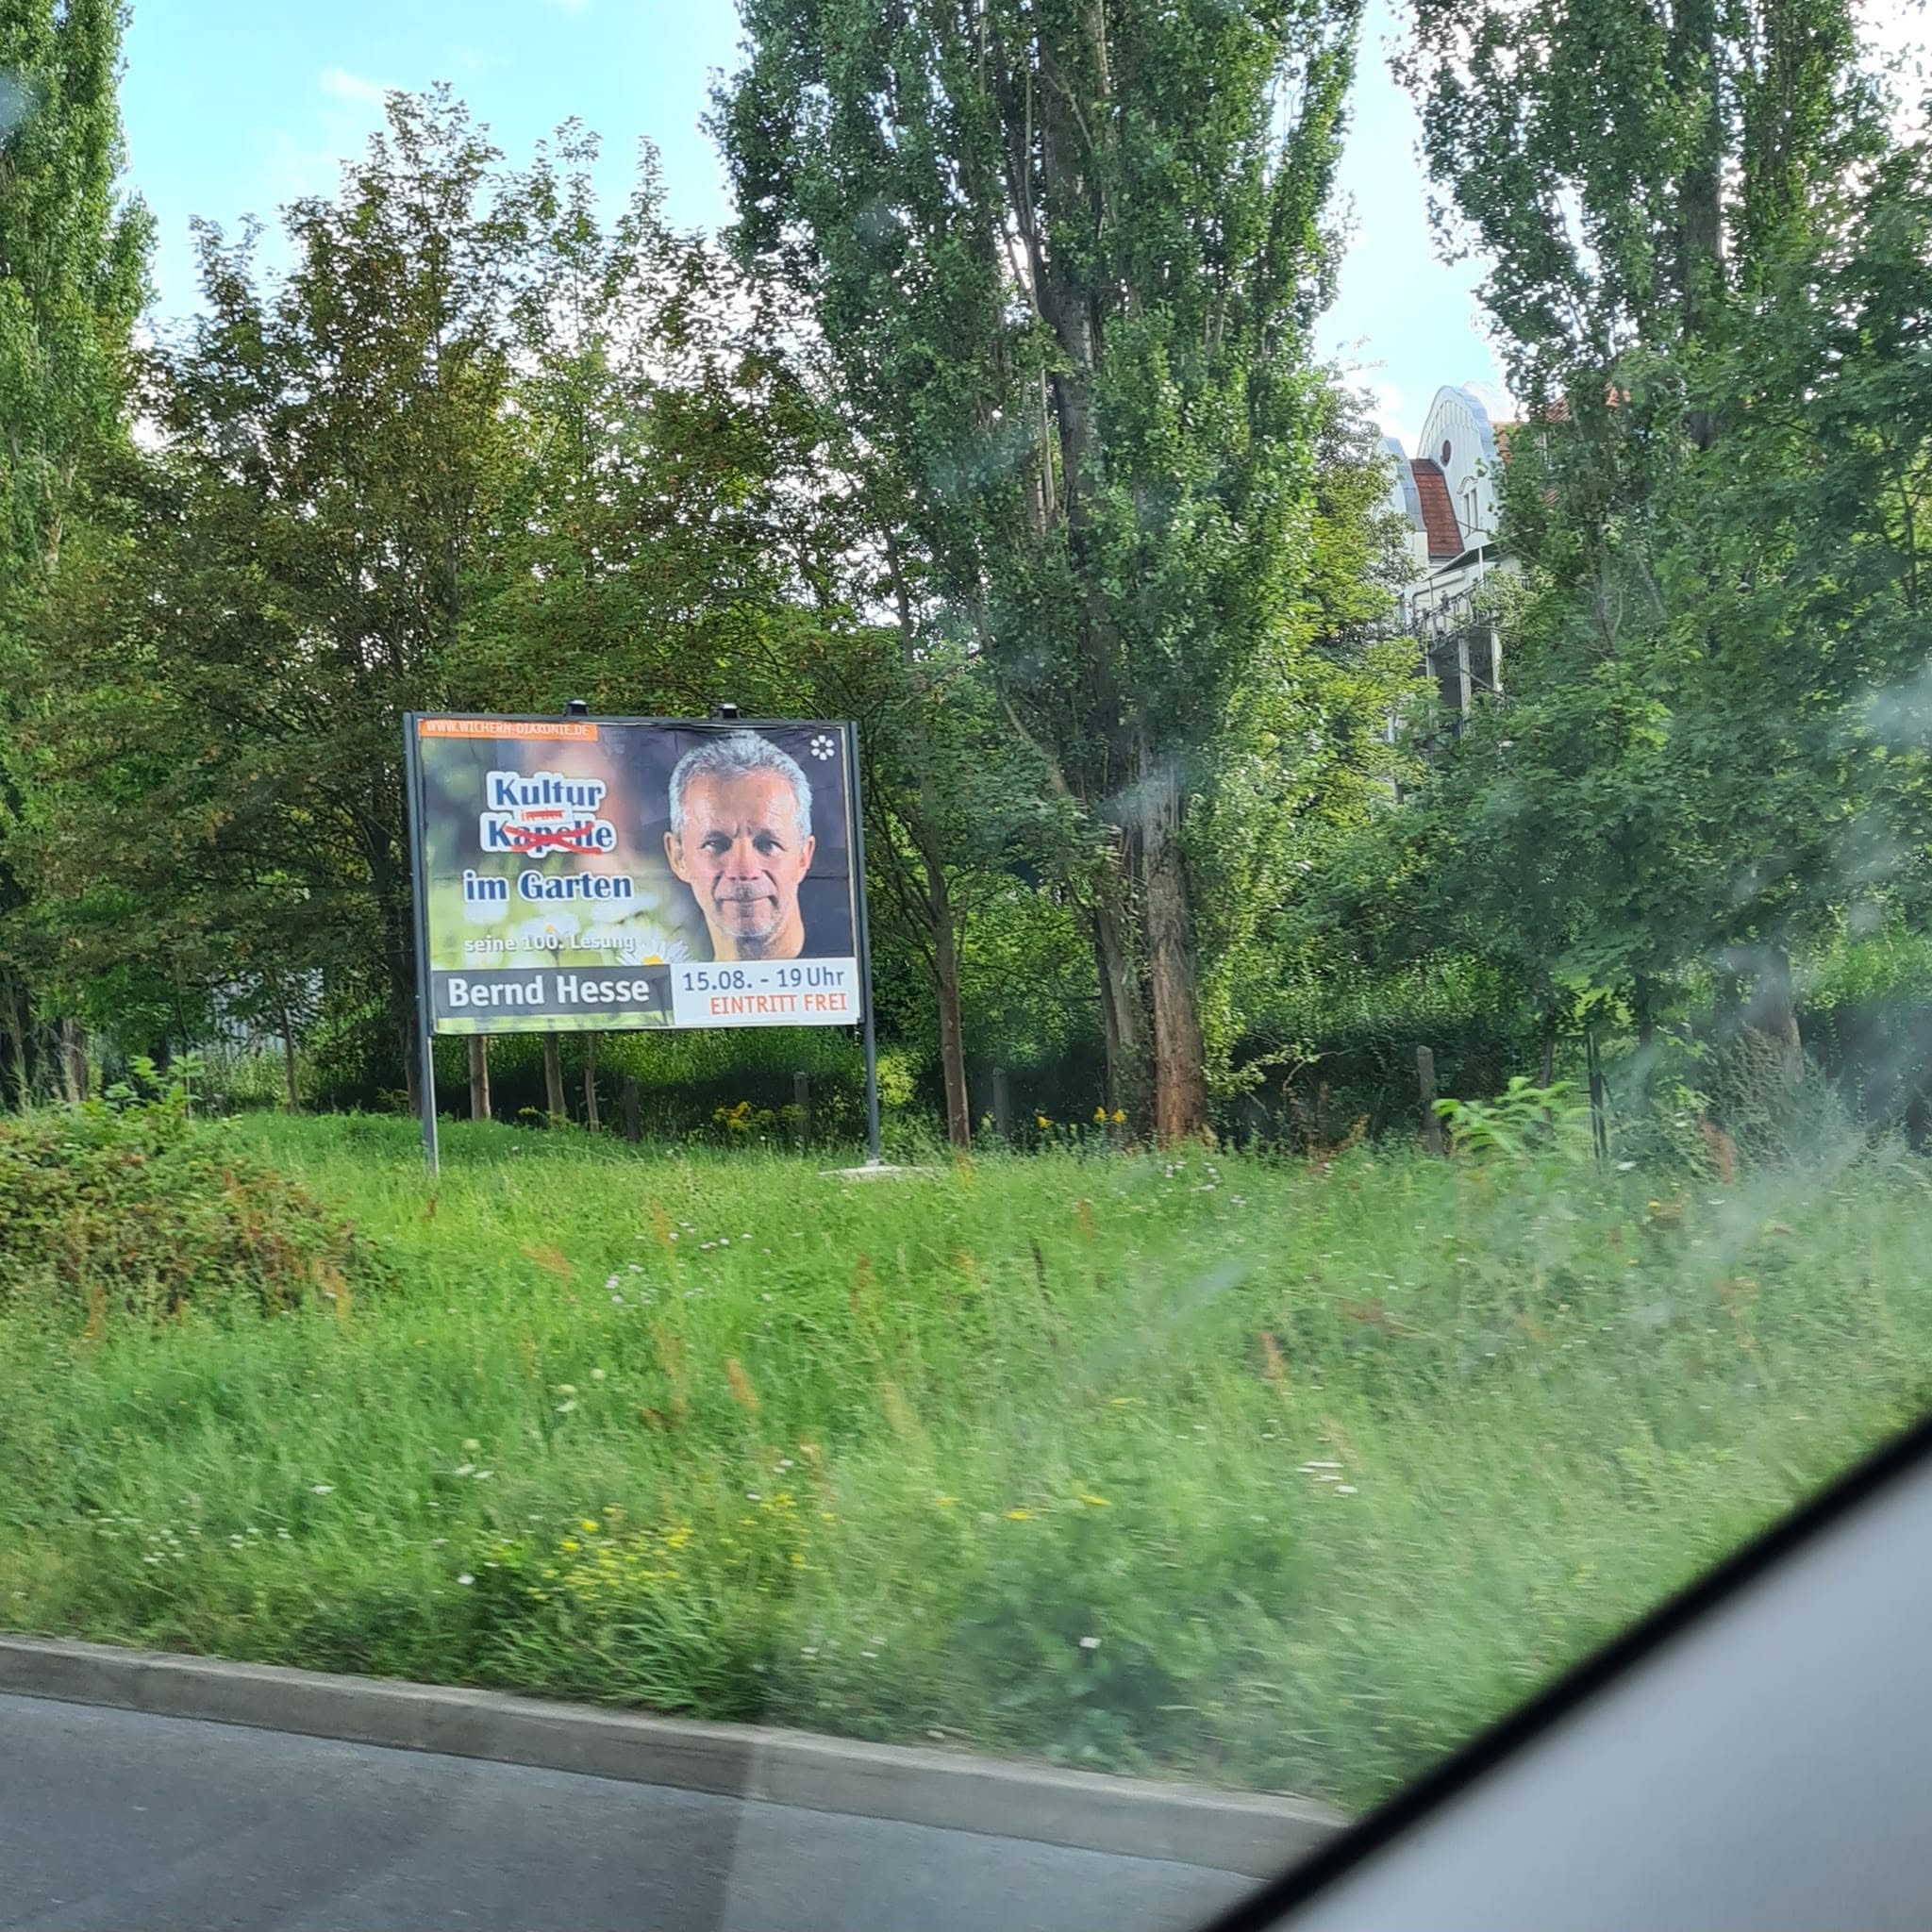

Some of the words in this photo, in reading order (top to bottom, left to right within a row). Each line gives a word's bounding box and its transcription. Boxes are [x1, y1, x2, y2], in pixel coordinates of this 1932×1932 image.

[495, 778, 603, 807] Kultur
[466, 873, 507, 900] im
[520, 872, 632, 900] Garten
[464, 935, 517, 952] seine
[522, 935, 565, 951] 100.
[571, 935, 636, 955] Lesung
[448, 974, 545, 1008] Bernd
[556, 974, 650, 1005] Hesse
[683, 970, 753, 991] 15.08.
[808, 966, 845, 987] Uhr
[710, 994, 798, 1015] EINTRITT
[804, 992, 848, 1012] FREI
